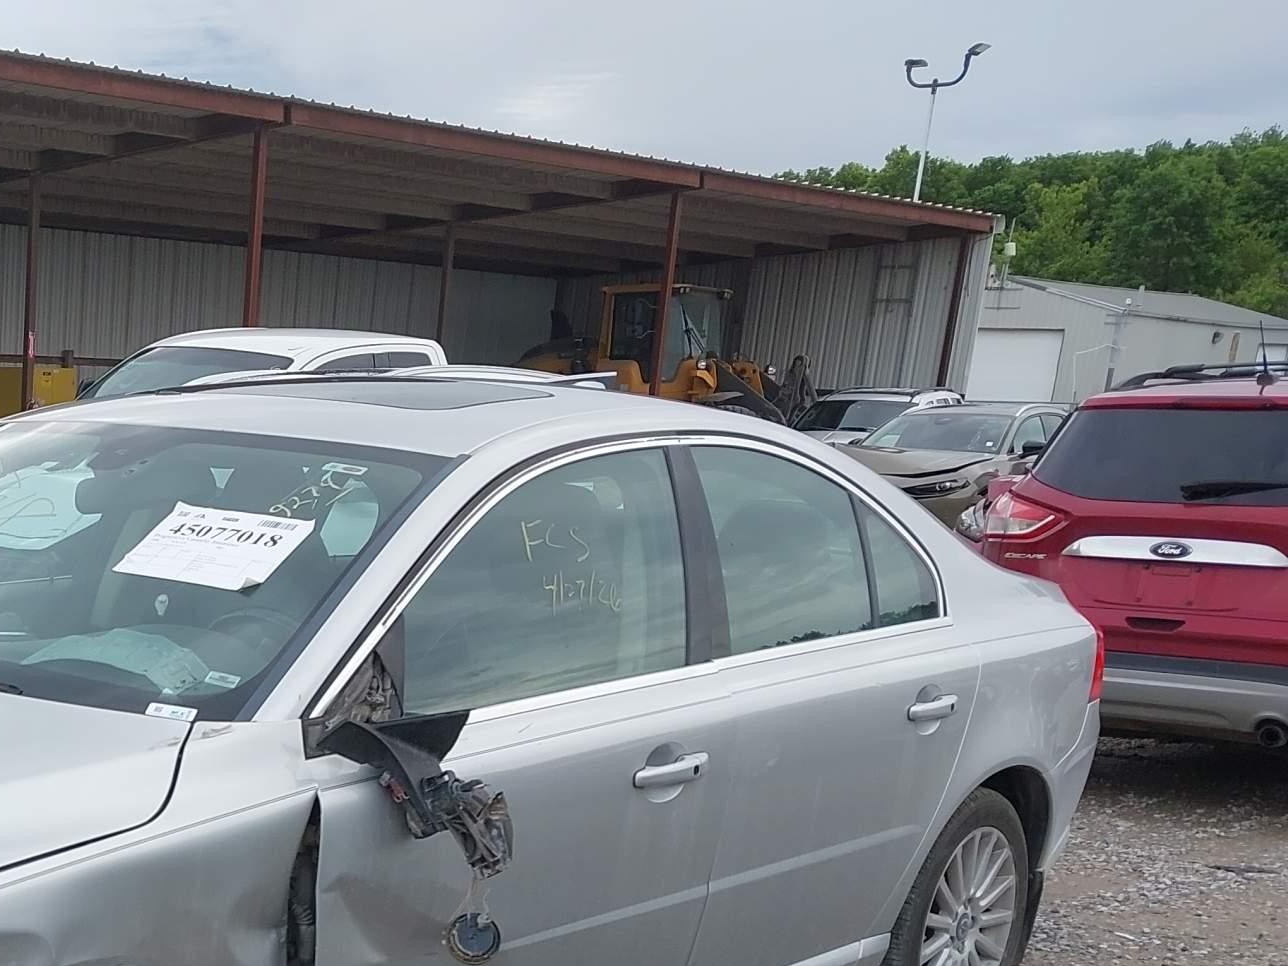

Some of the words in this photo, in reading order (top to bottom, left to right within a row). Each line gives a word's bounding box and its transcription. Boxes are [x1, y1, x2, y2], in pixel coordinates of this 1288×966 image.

[168, 522, 284, 549] 45077018
[520, 519, 591, 563] FCS
[1157, 543, 1183, 555] Ford
